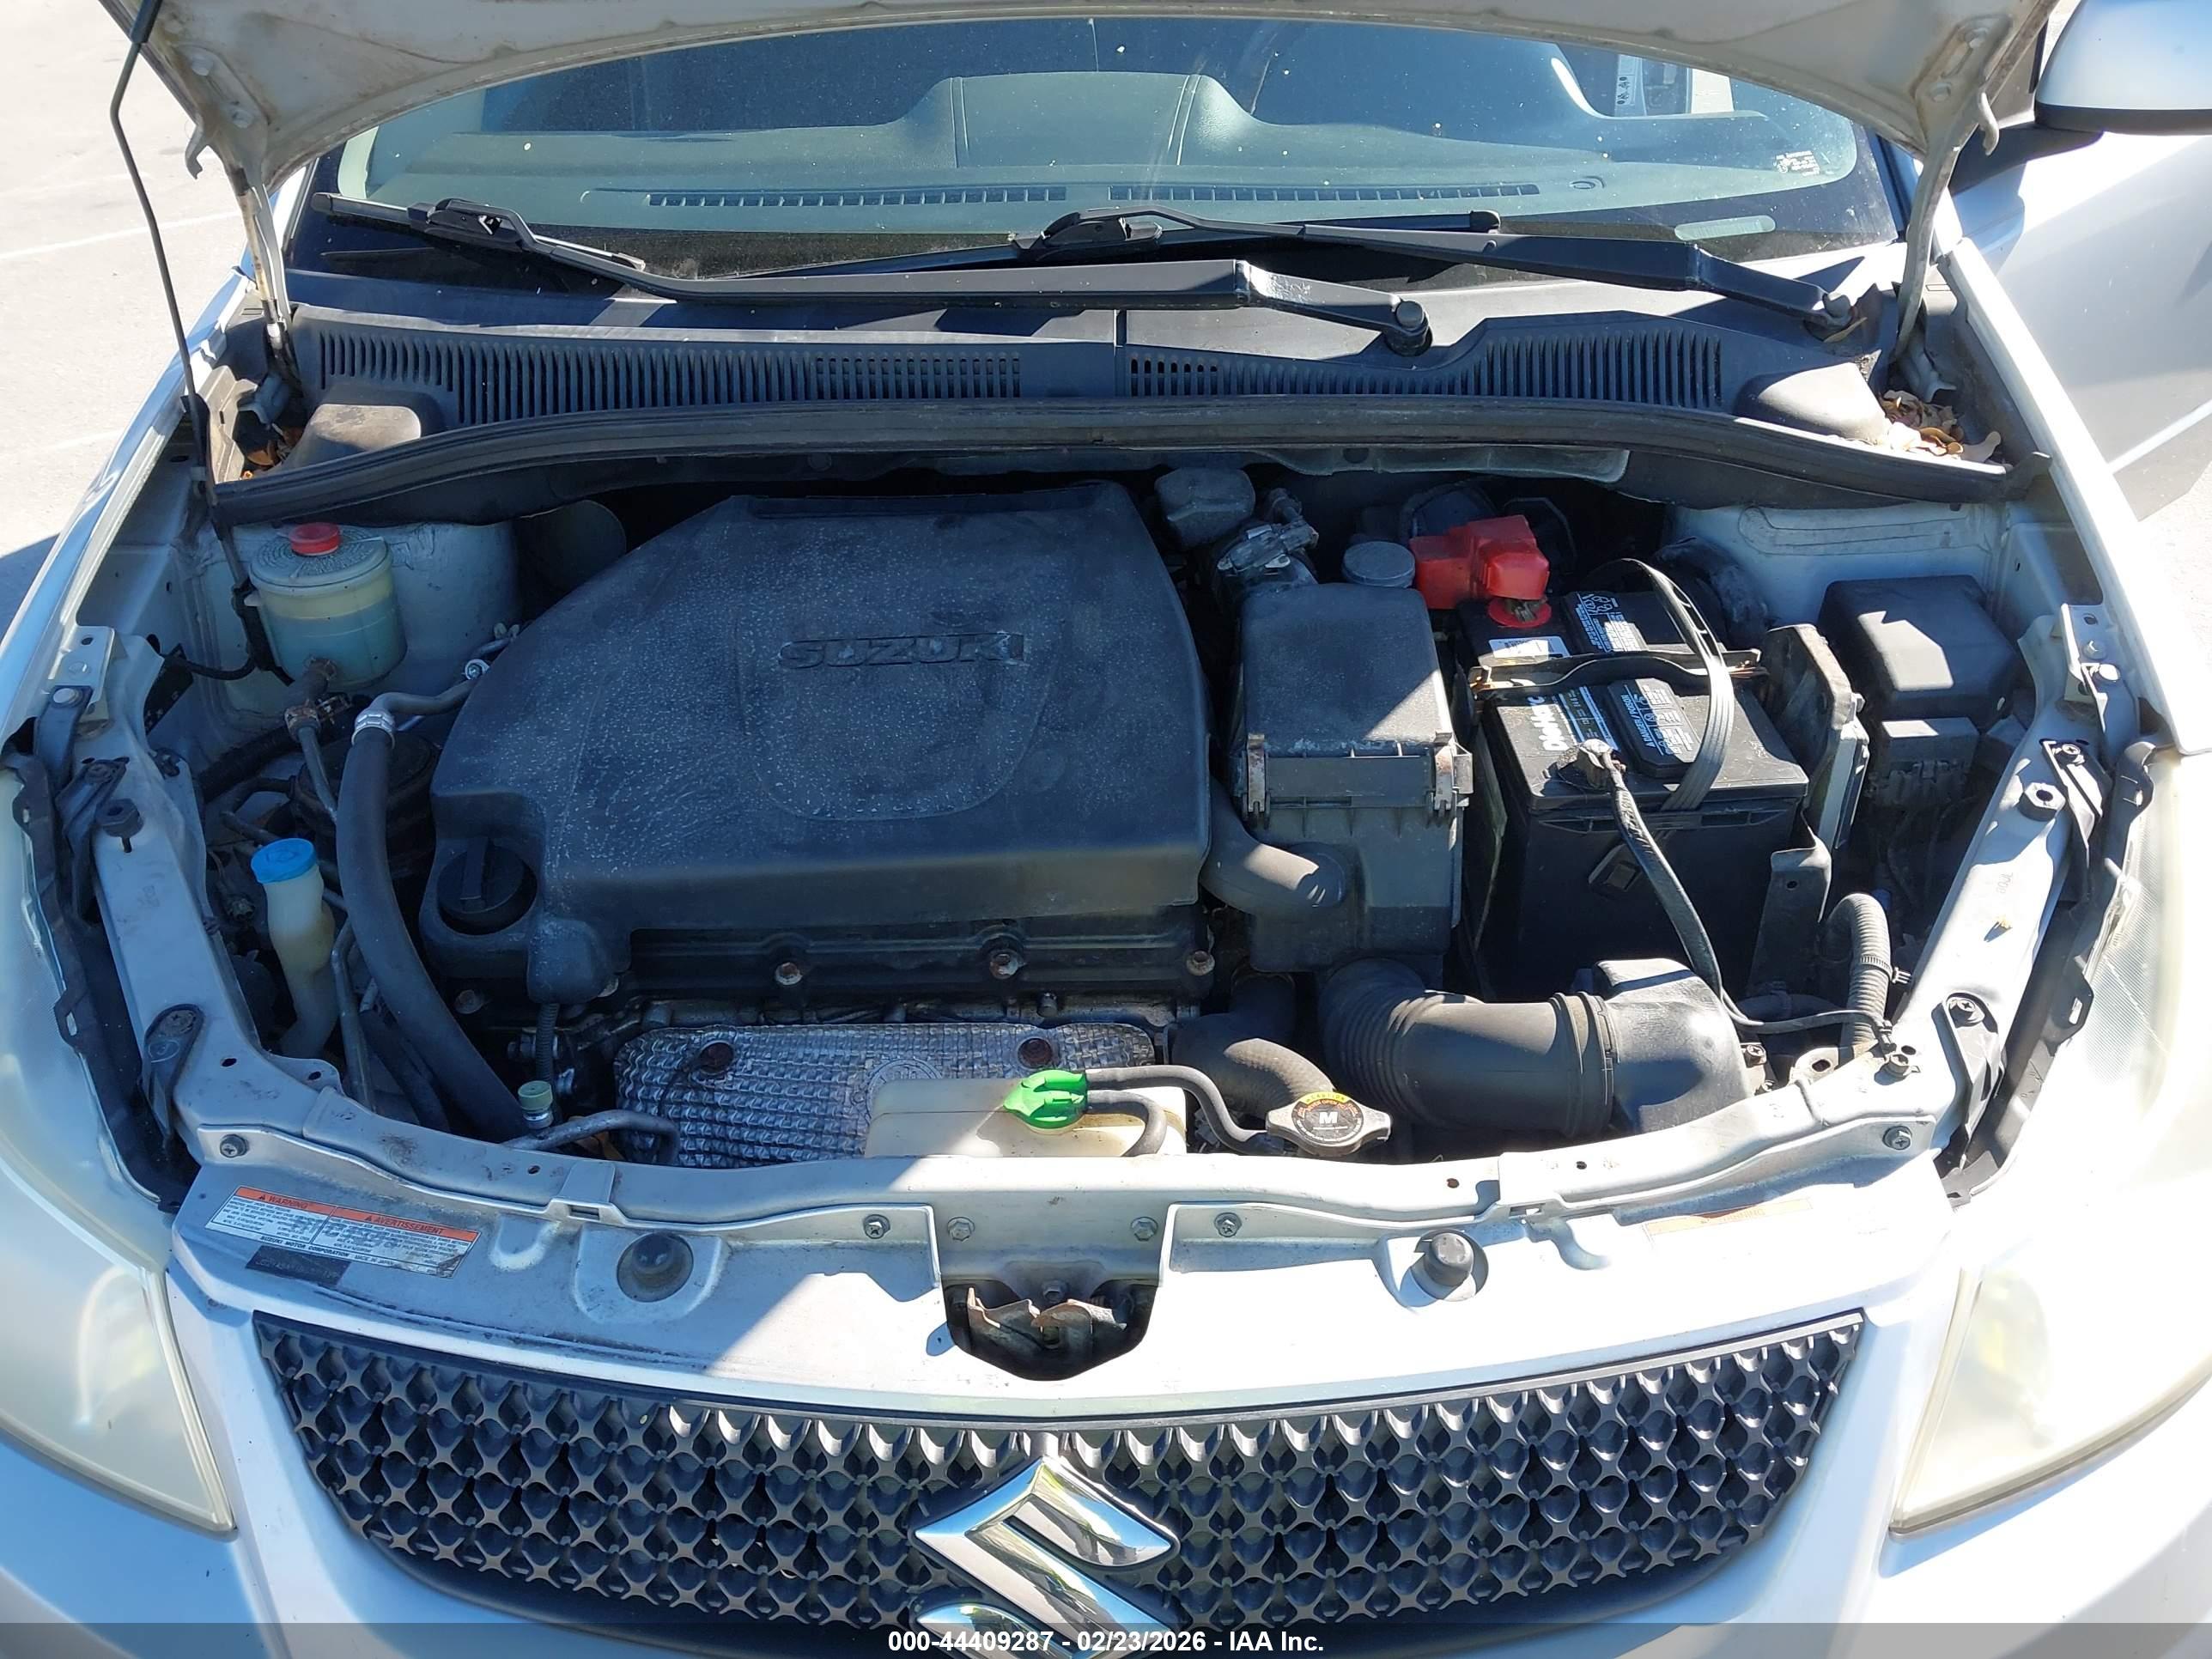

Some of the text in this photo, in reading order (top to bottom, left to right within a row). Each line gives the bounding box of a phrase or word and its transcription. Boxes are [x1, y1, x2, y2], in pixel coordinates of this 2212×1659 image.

[779, 632, 1029, 668] SUZUKI
[1319, 1111, 1339, 1124] M
[268, 1195, 309, 1209] WARNING
[374, 1215, 446, 1235] AVERTISSEMENT
